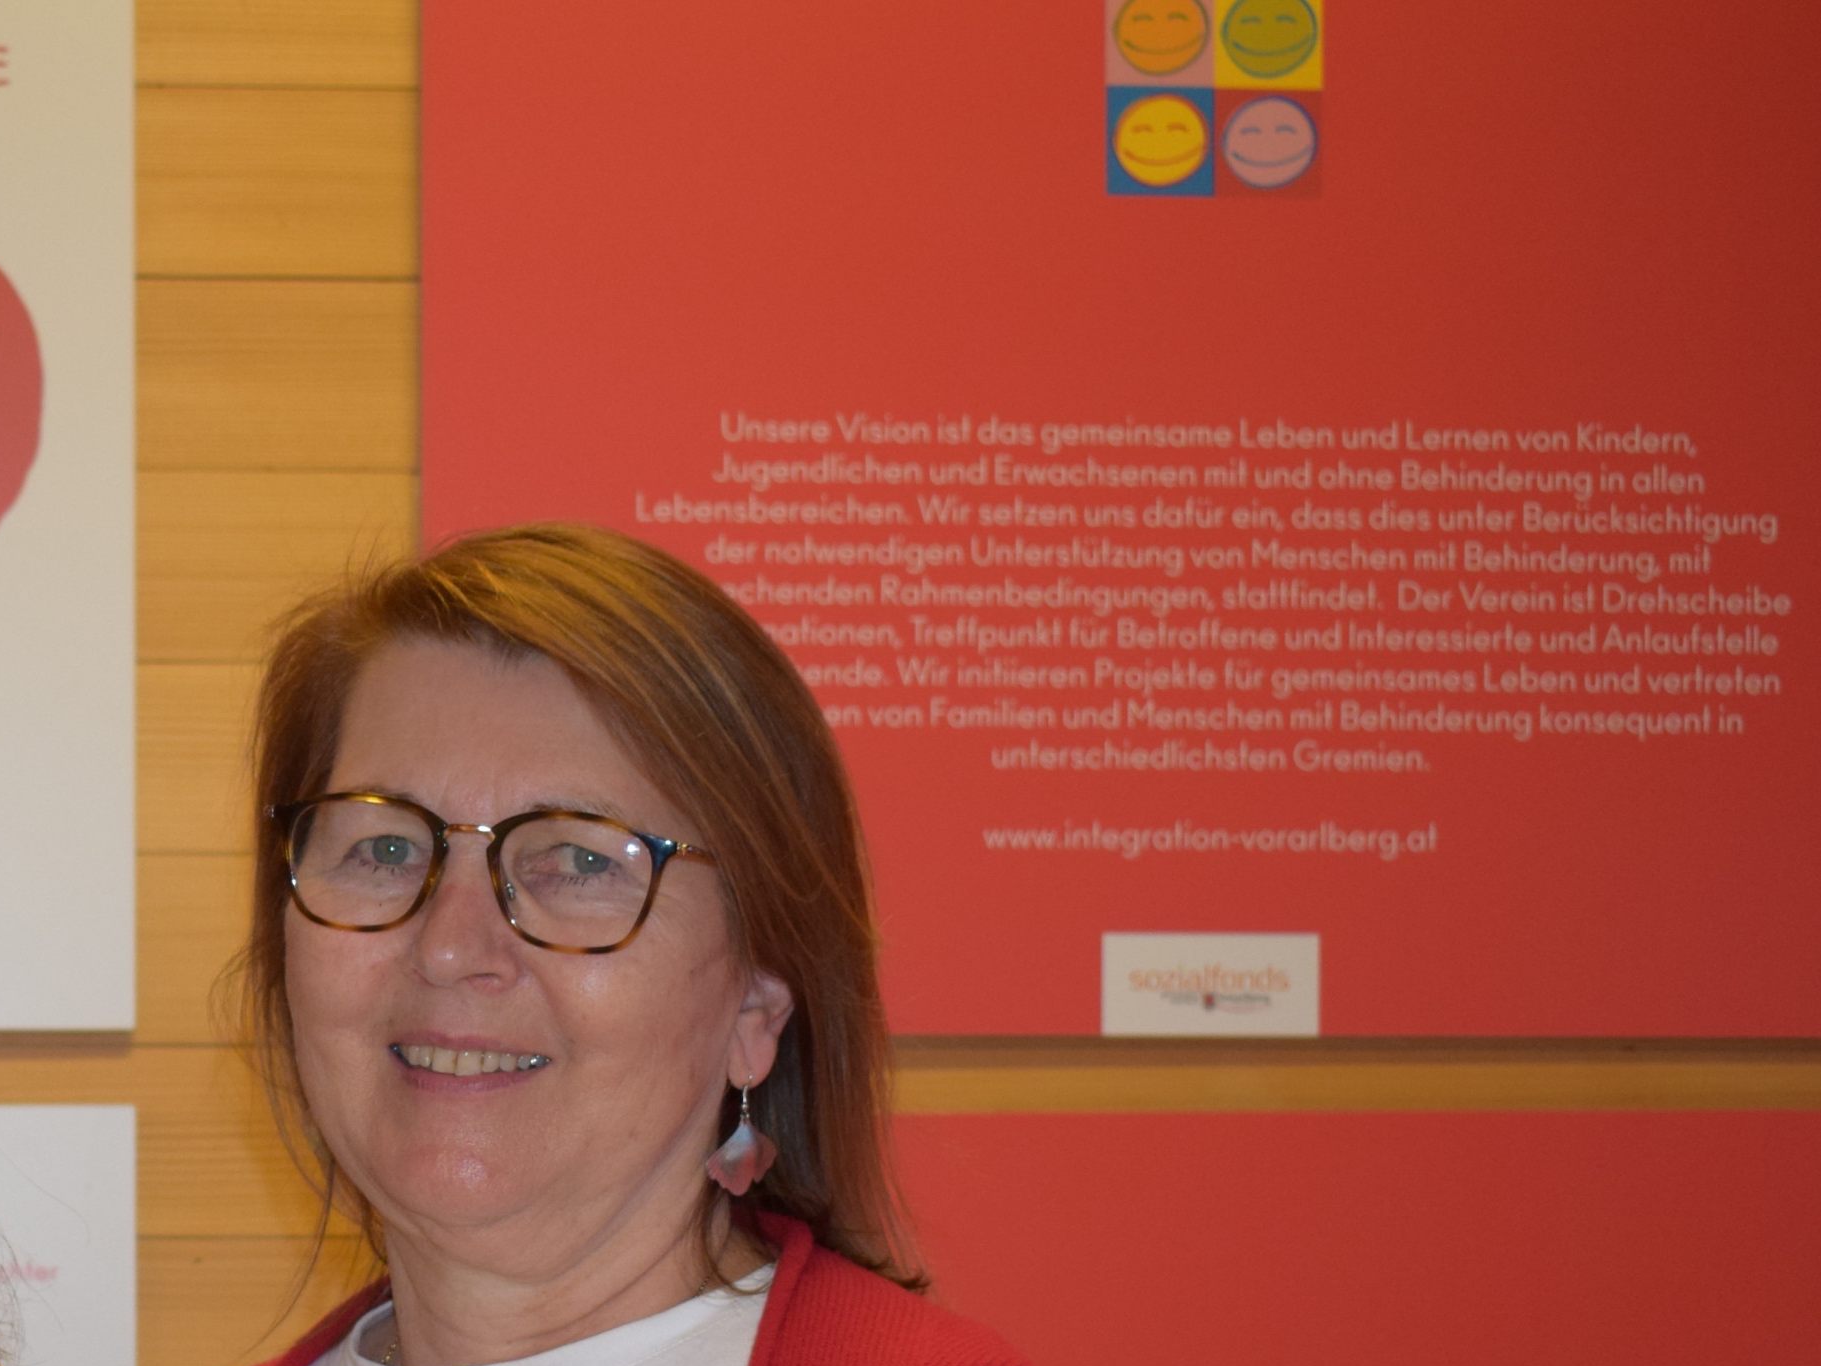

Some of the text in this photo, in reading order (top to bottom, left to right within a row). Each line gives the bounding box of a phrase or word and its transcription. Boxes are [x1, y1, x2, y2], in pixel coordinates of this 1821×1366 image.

[721, 411, 1696, 459] Unsere Vision ist das gemeinsame Leben und Lernen von Kindern,
[713, 452, 1705, 500] Jugendlichen und Erwachsenen mit und ohne Behinderung in allen
[636, 491, 1778, 542] Lebensbereichen. Wir setzen uns dafür ein, dass dies unter Berücksichtigung
[704, 532, 1711, 581] der notwendigen Unterstützung von Menschen mit Behinderung, mit
[881, 575, 1214, 616] Rahmenbedingungen,
[1223, 577, 1381, 608] stattfindet.
[1398, 579, 1452, 610] Der
[1459, 580, 1556, 611] Verein
[1563, 581, 1595, 612] ist
[1603, 582, 1791, 613] Drehscheibe
[911, 615, 1062, 656] Treffpunkt
[1069, 616, 1109, 647] für
[1117, 617, 1278, 648] Betroffene
[1285, 619, 1342, 650] und
[1349, 620, 1533, 651] Interessierte
[1540, 621, 1596, 652] und
[1603, 622, 1779, 653] Anlaufstelle
[897, 654, 949, 685] Wir
[1094, 657, 1217, 698] Projekte
[1224, 657, 1263, 688] für
[1271, 659, 1476, 700] gemeinsames
[1483, 661, 1577, 692] Leben
[1584, 662, 1640, 693] und
[1647, 662, 1780, 693] vertreten
[868, 704, 923, 726] von
[930, 695, 1056, 726] Familien
[1063, 697, 1121, 728] und
[1127, 698, 1283, 729] Menschen
[1290, 698, 1333, 729] mit
[1340, 699, 1533, 740] Behinderung
[1540, 701, 1711, 742] konsequent
[1719, 702, 1744, 733] in
[991, 737, 1428, 770] unterschiedlichsten Gremien.
[983, 819, 1438, 858] www.integration-vorarlberg.at
[1127, 963, 1291, 995] sozialfonds
